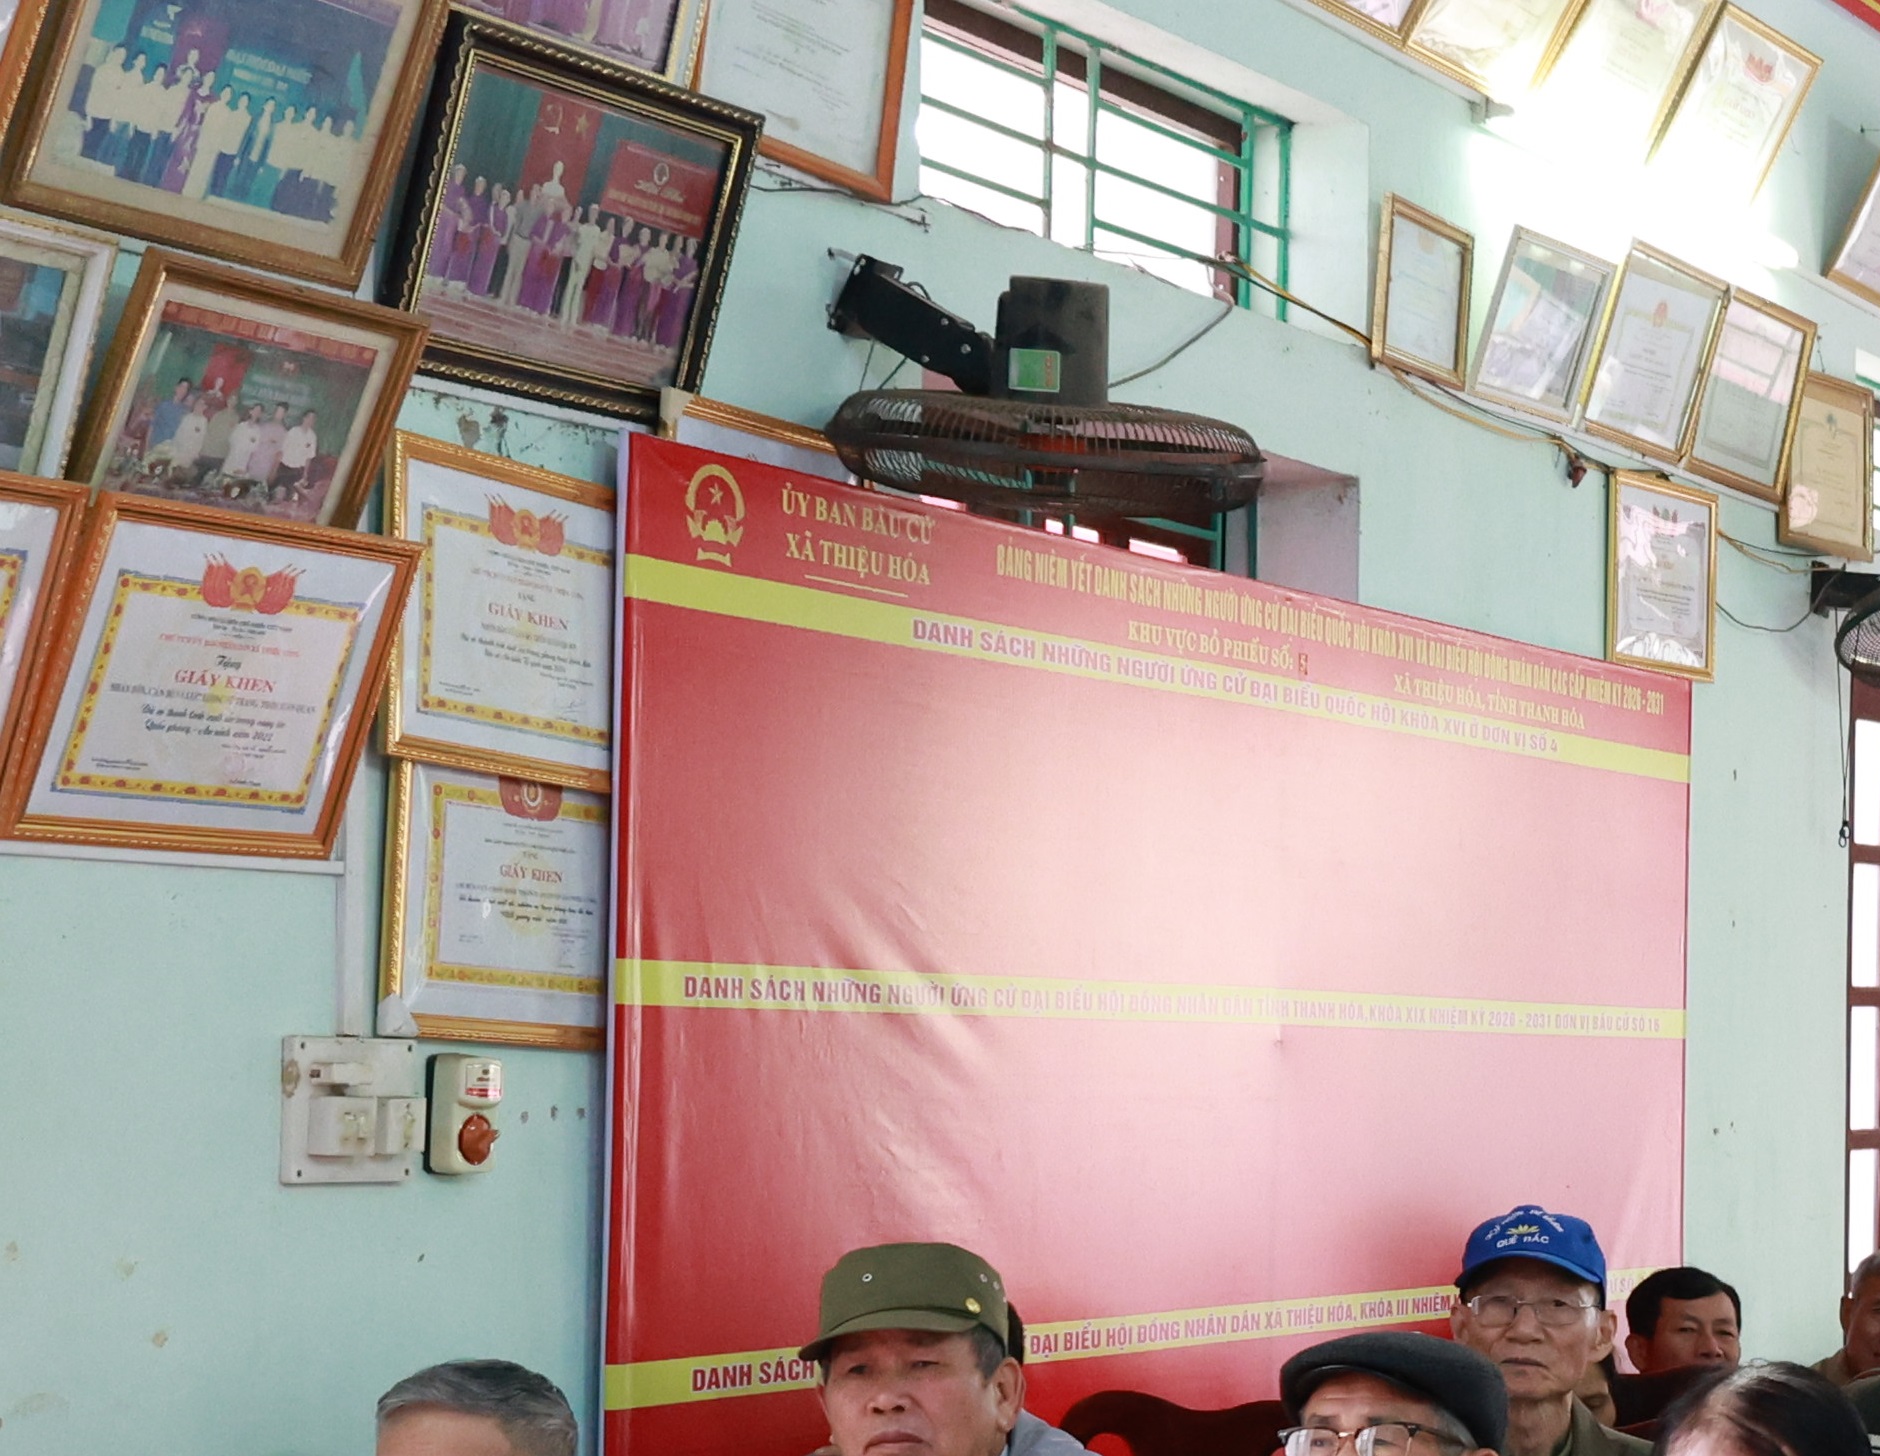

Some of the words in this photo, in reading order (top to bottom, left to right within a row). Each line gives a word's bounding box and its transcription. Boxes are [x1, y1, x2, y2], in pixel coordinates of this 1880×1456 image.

[815, 496, 856, 528] BAN
[861, 505, 901, 539] BẦU
[906, 514, 936, 545] CỬ
[786, 530, 815, 562] XÃ
[819, 539, 884, 578] THIỆU
[488, 602, 523, 622] GIẤY
[527, 610, 569, 631] KHEN
[1071, 553, 1092, 594] YẾT
[1095, 565, 1127, 601] DANH
[1398, 633, 1414, 661] XVI
[1623, 684, 1641, 711] 2026
[1647, 690, 1664, 716] 2031
[1128, 619, 1162, 645] KHU
[1165, 627, 1197, 655] VỰC
[1201, 628, 1220, 656] BỎ
[1223, 636, 1269, 665] PHIẾU
[174, 669, 220, 688] GIẤY
[225, 675, 277, 694] KHEN
[913, 619, 973, 648] DANH
[980, 630, 1035, 660] SÁCH
[1042, 643, 1111, 673] NHỮNG
[1118, 656, 1174, 684] NGƯỜI
[1181, 664, 1217, 690] ỨNG
[1223, 671, 1247, 695] CỬ
[1250, 681, 1278, 704] ĐẠI
[1283, 684, 1320, 709] BIỂU
[1325, 694, 1366, 718] QUỐC
[1371, 703, 1396, 726] HỘI
[1400, 708, 1439, 733] KHÓA
[1443, 717, 1466, 738] XVI
[1482, 725, 1510, 746] ĐƠN
[1514, 733, 1526, 752] VỊ
[1529, 731, 1546, 752] SỐ
[1550, 739, 1558, 752] 4
[1394, 671, 1412, 696] XÃ
[1414, 677, 1455, 705] THIỆU
[1519, 700, 1560, 726] THANH
[1562, 706, 1585, 730] HÓA
[499, 862, 528, 879] GIẤY
[684, 976, 743, 1000] DANH
[750, 975, 806, 1001] SÁCH
[812, 978, 881, 1004] NHỮNG
[888, 980, 945, 1006] NGƯỜI
[950, 982, 988, 1008] ỨNG
[994, 983, 1017, 1009] CỬ
[1022, 990, 1049, 1014] ĐẠI
[1055, 984, 1092, 1012] BIỂU
[1098, 990, 1124, 1017] HỘI
[1129, 990, 1172, 1014] ĐỒNG
[1177, 992, 1219, 1016] NHÂN
[1293, 1001, 1336, 1020] THANH
[1369, 1002, 1401, 1023] KHÓA
[1405, 1007, 1426, 1024] XIX
[1429, 1006, 1468, 1030] NHIỆM
[1525, 1013, 1551, 1029] 2031
[1496, 1234, 1518, 1248] QUÊ
[1030, 1334, 1060, 1357] ĐẠI
[1064, 1322, 1101, 1353] BIỂU
[1106, 1326, 1134, 1351] HỘI
[1137, 1321, 1179, 1347] ĐỒNG
[1183, 1314, 1226, 1342] NHÂN
[1231, 1309, 1260, 1332] DÂN
[1264, 1308, 1283, 1331] XÃ
[1287, 1304, 1324, 1328] THIỆU
[1327, 1301, 1356, 1323] HÓA,
[1360, 1297, 1393, 1320] KHÓA
[1397, 1300, 1408, 1316] III
[1412, 1293, 1450, 1316] NHIỆM
[692, 1365, 752, 1392] DANH
[759, 1355, 815, 1386] SÁCH
